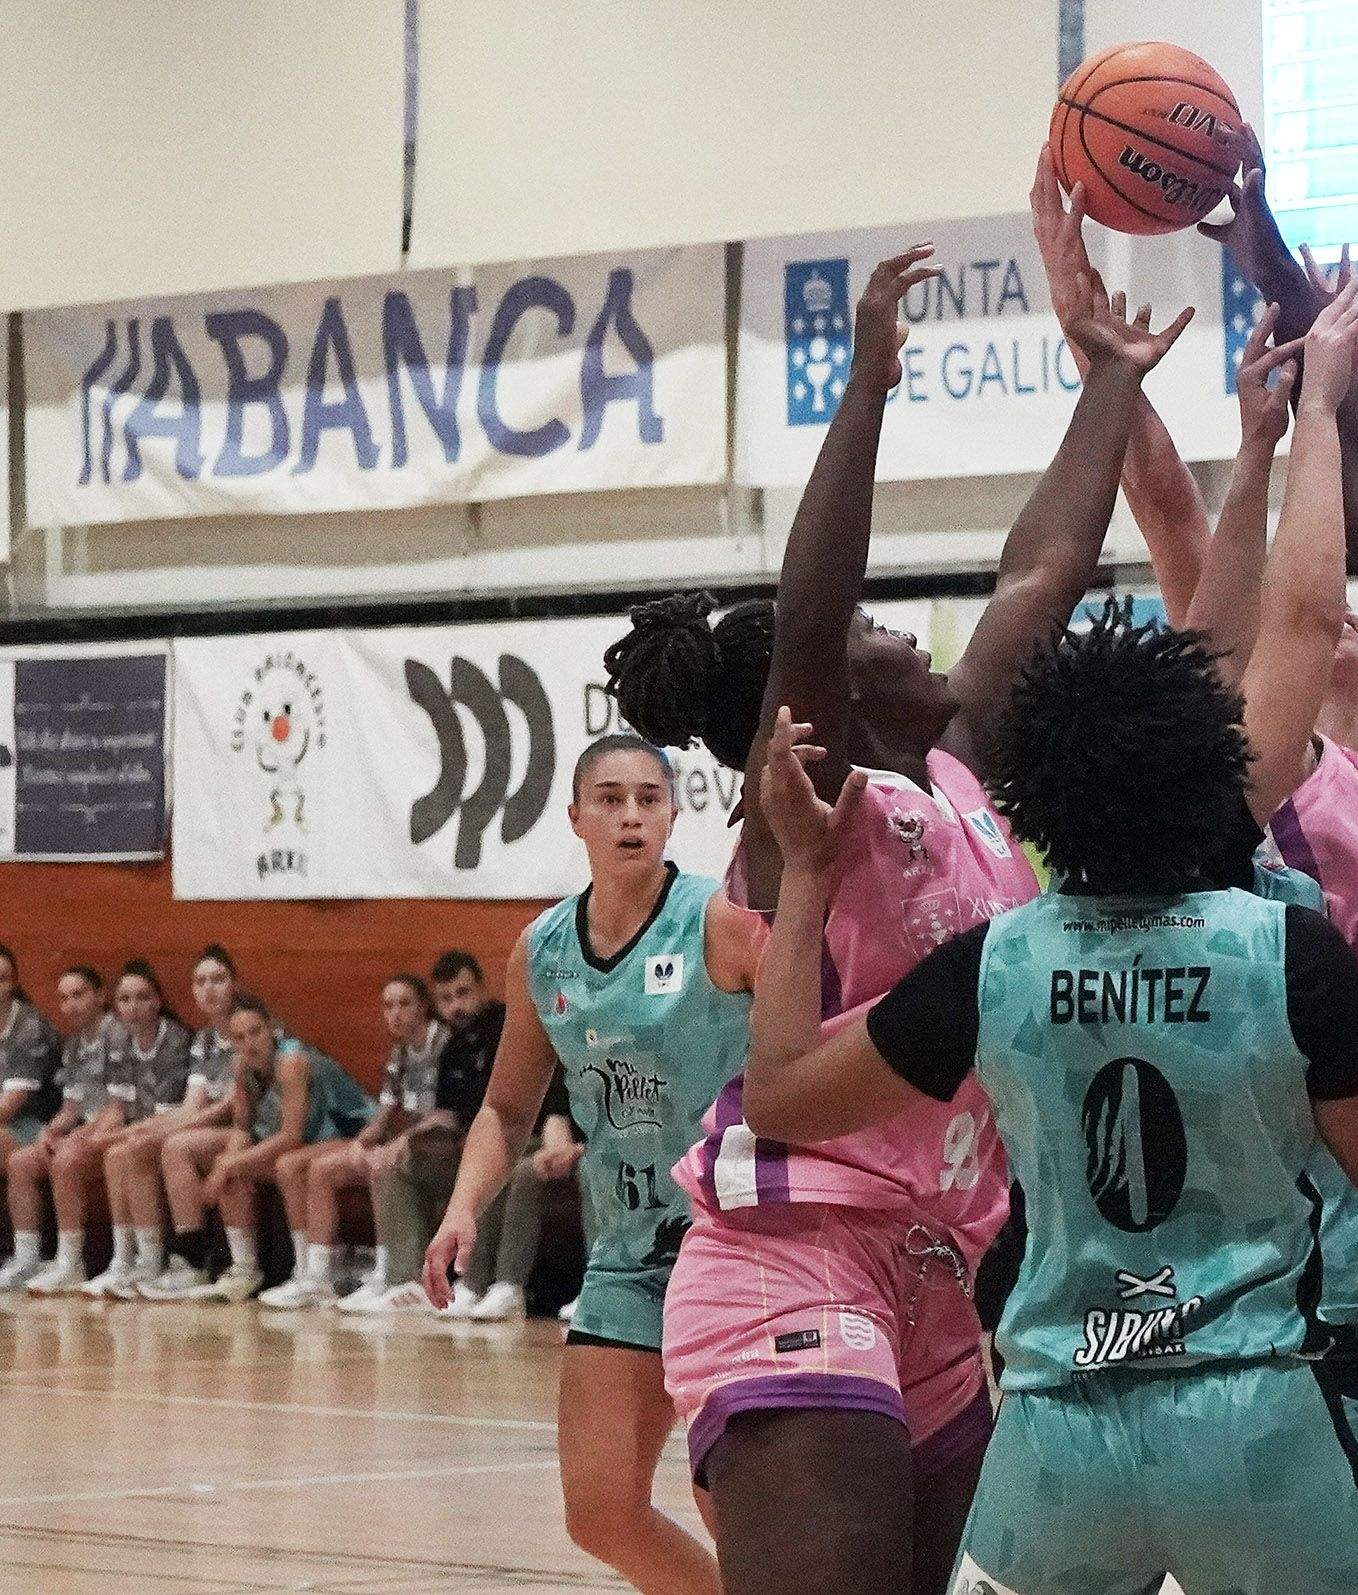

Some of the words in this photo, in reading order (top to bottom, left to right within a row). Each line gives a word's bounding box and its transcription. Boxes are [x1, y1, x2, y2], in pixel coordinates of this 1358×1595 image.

[902, 257, 1029, 327] UNTA
[78, 266, 664, 486] ABANCA
[941, 329, 1084, 401] GALIC
[1051, 953, 1212, 1025] BENÍTEZ
[614, 1074, 668, 1104] Pellet
[1082, 1056, 1188, 1234] 0
[616, 1161, 670, 1211] 61
